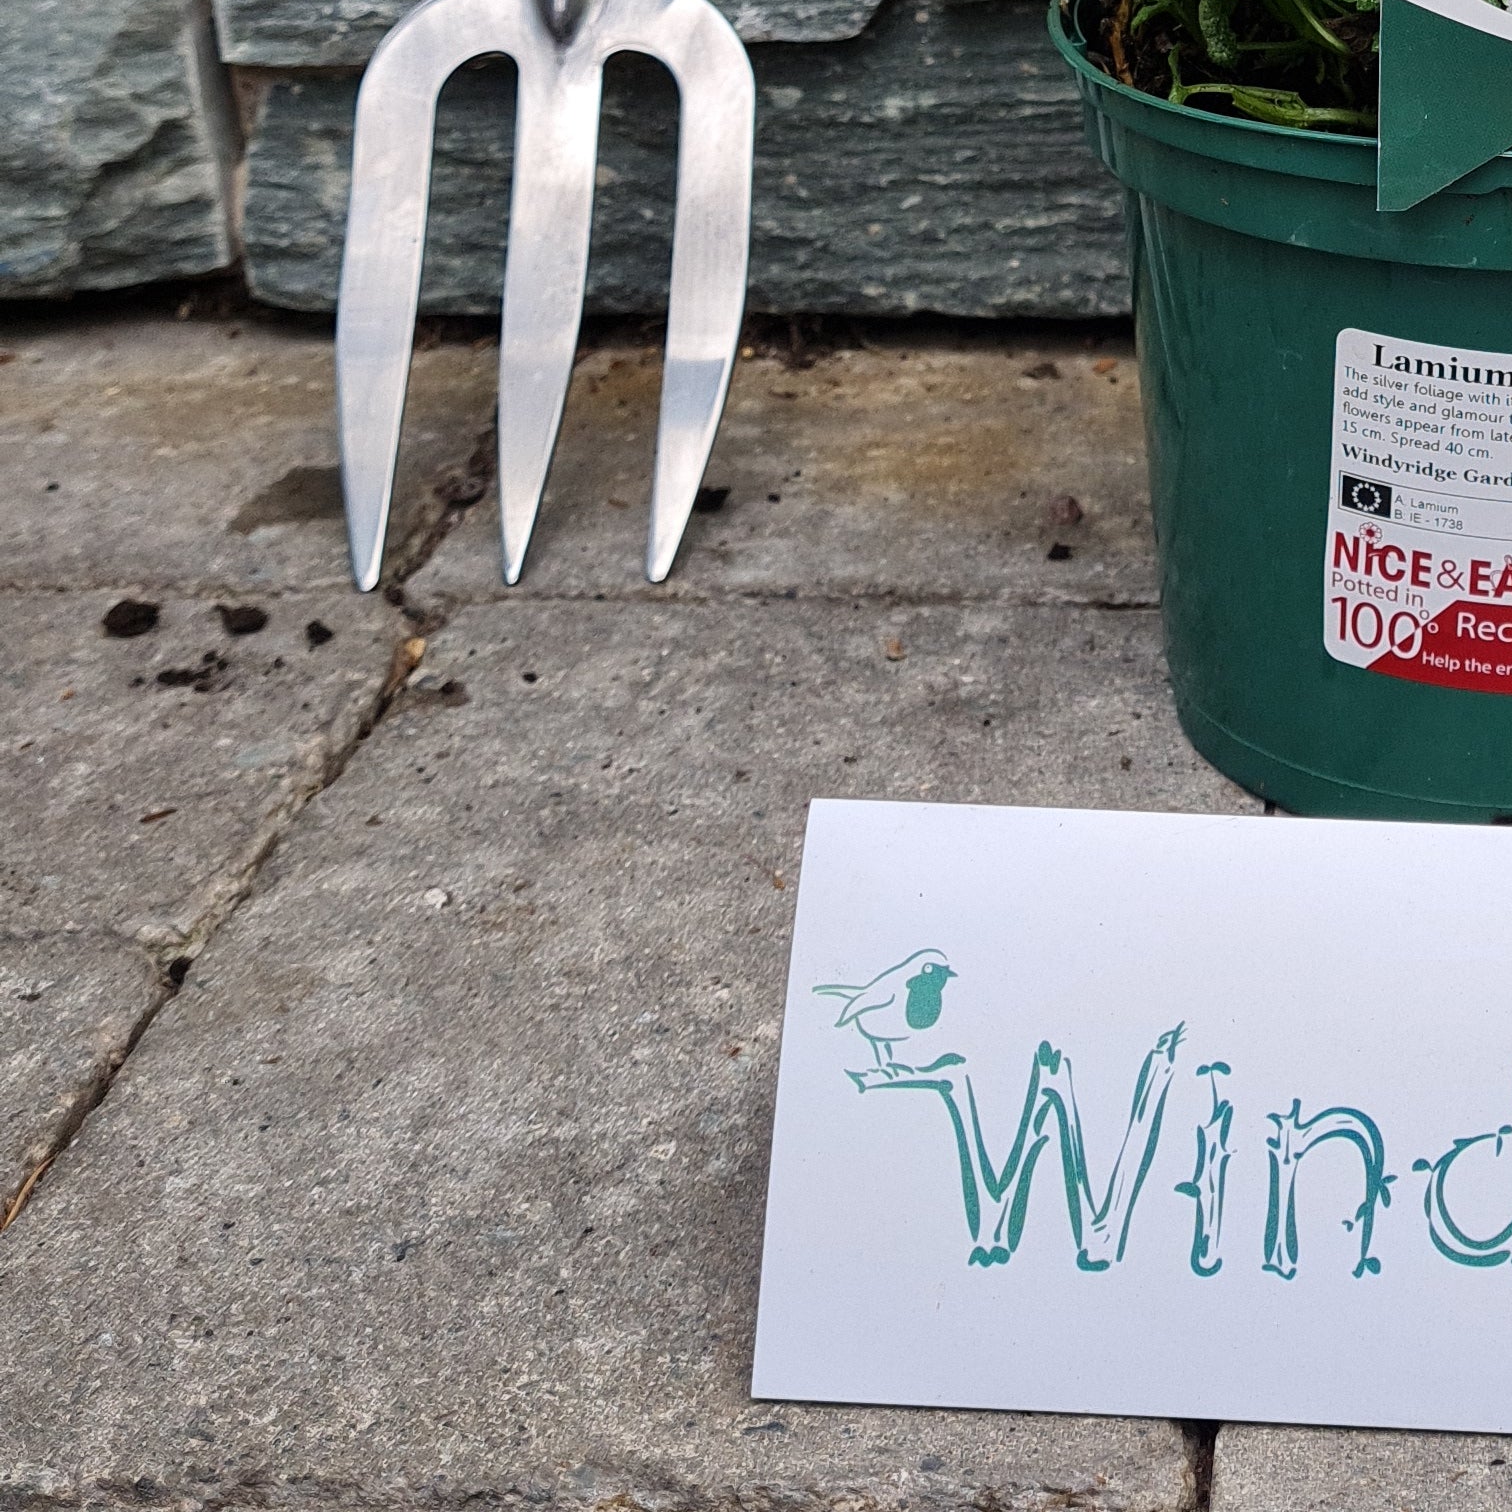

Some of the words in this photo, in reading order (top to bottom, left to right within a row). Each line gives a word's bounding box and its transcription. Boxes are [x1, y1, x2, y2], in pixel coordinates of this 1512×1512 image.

[1344, 365, 1368, 383] The
[1373, 374, 1408, 392] silver
[1414, 382, 1464, 402] foliage
[1468, 393, 1500, 405] with
[1343, 386, 1368, 400] add
[1373, 394, 1404, 409] style
[1410, 402, 1436, 415] and
[1441, 405, 1503, 424] glamour
[1343, 401, 1391, 425] flowers
[1395, 417, 1446, 435] appear
[1451, 424, 1484, 440] from
[1343, 419, 1357, 434] 15
[1362, 427, 1385, 442] cm.
[1391, 431, 1441, 452] Spread
[1444, 442, 1464, 456] 40
[1468, 447, 1494, 460] cm.
[1341, 442, 1458, 482] Windyridge
[1410, 513, 1421, 523] IE
[1435, 518, 1463, 530] 1738
[1411, 498, 1458, 514] Lamium
[1332, 572, 1398, 602] Potted
[1406, 588, 1423, 607] in
[1422, 651, 1460, 672] Help
[1464, 659, 1491, 674] the
